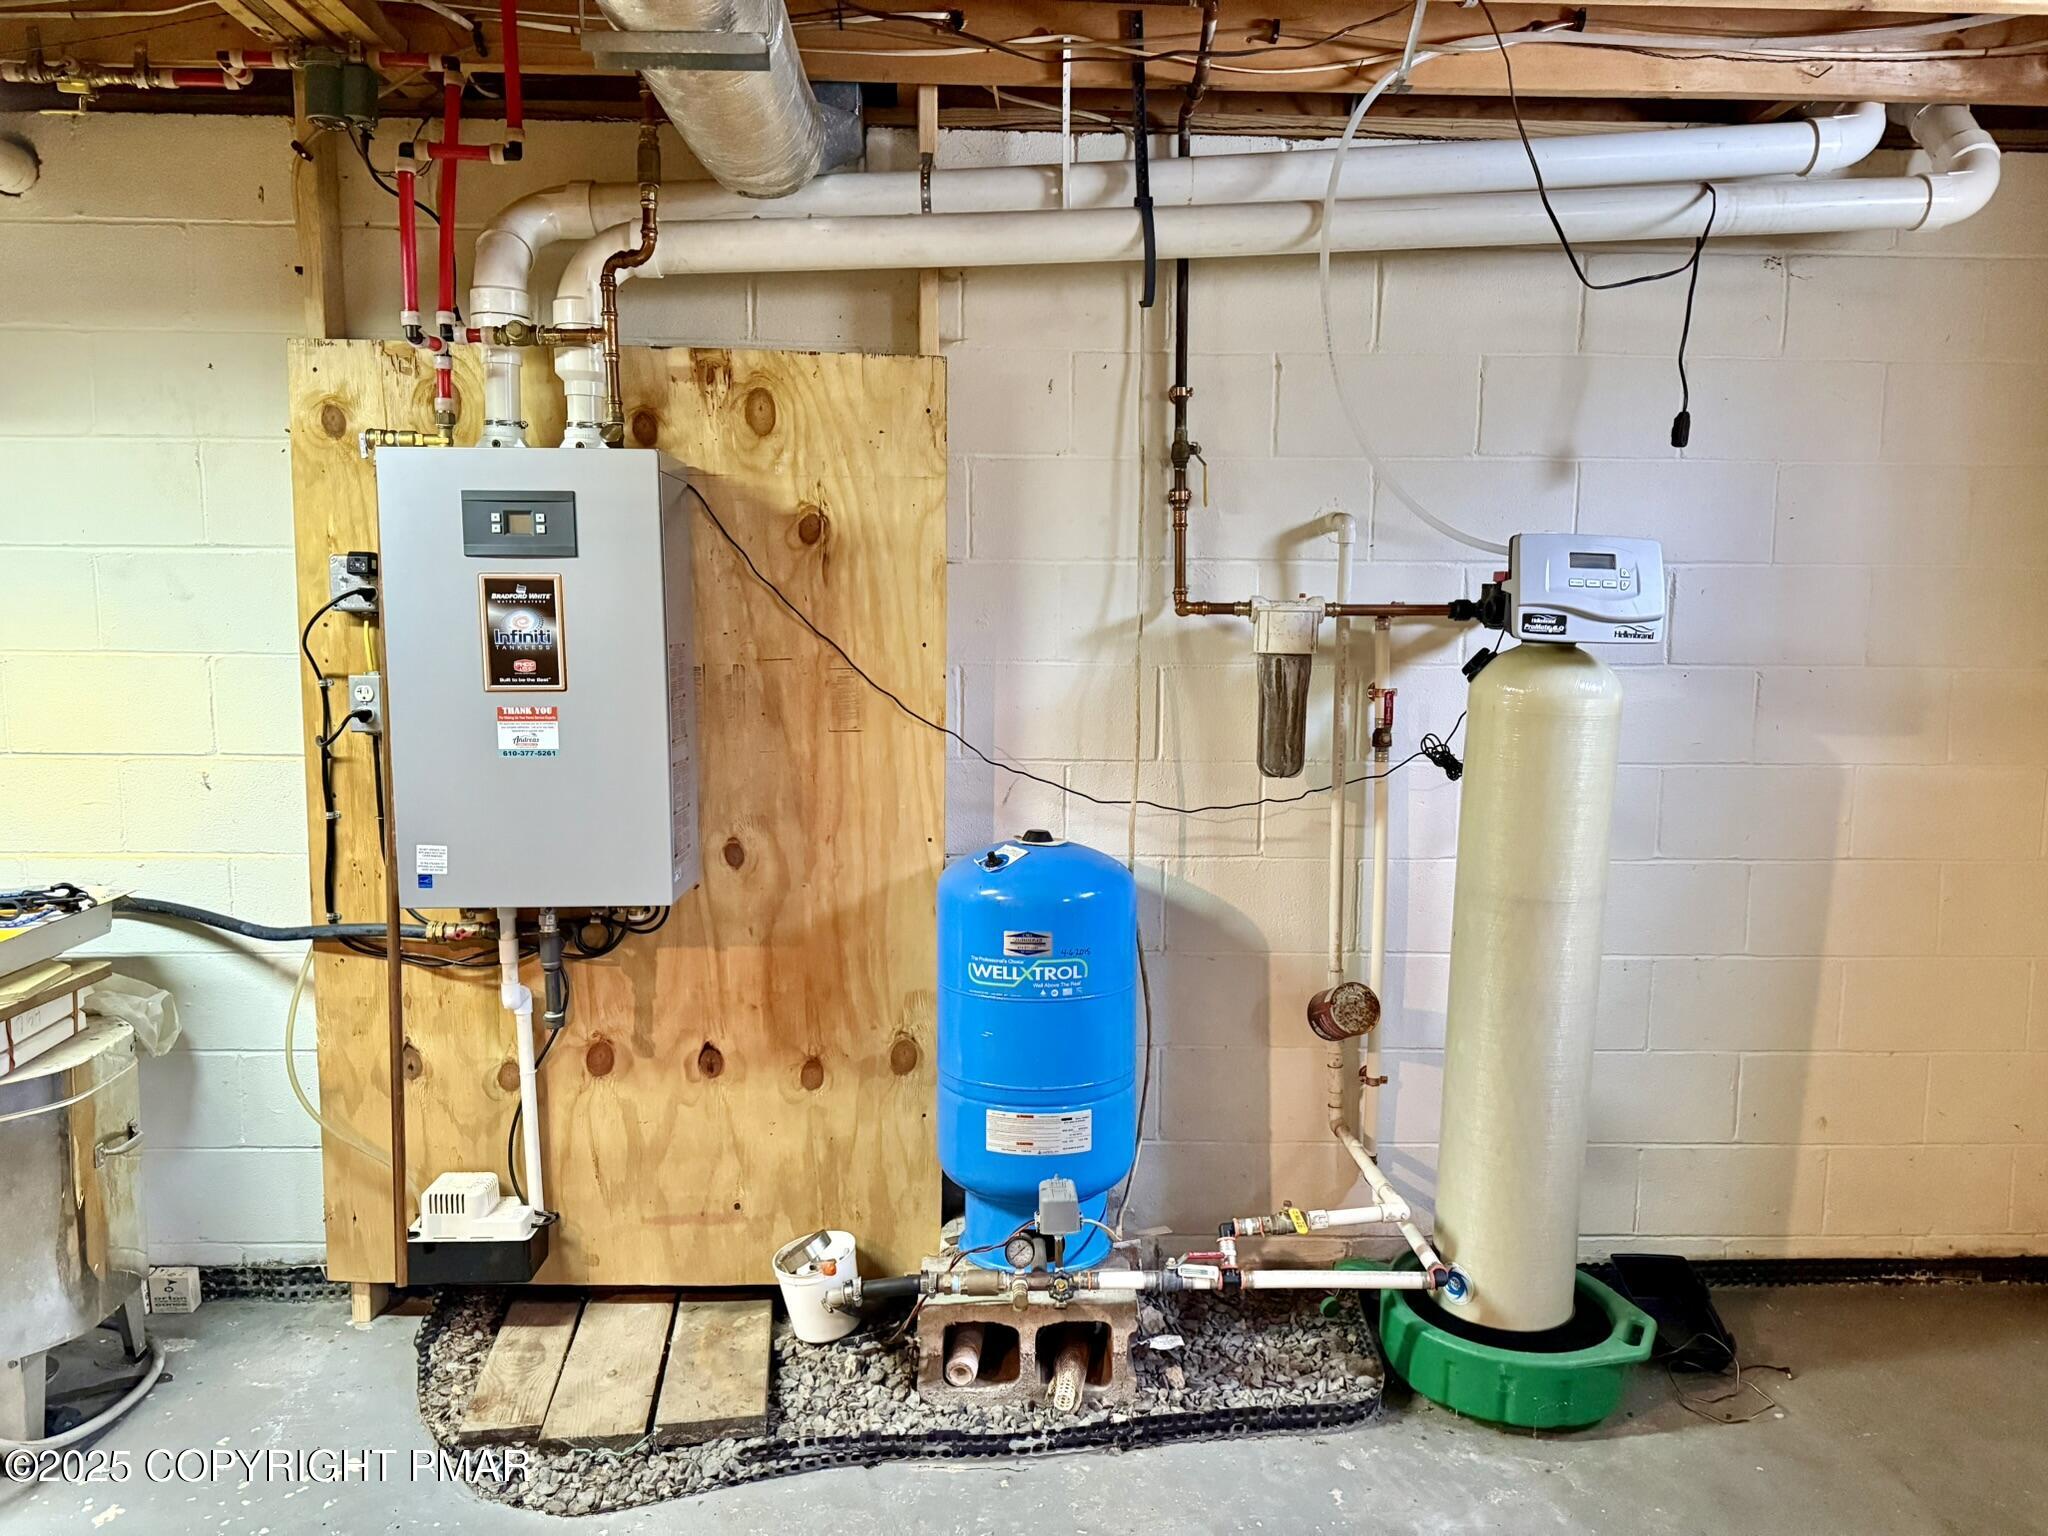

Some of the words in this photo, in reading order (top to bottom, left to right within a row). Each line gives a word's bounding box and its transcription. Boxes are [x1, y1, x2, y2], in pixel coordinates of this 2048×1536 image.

[491, 592, 528, 600] BRADFORD
[528, 592, 551, 600] WHITE
[494, 629, 552, 645] Infiniti
[1613, 630, 1655, 640] Hellenbrand
[502, 707, 532, 715] THANK
[534, 707, 552, 715] YOU
